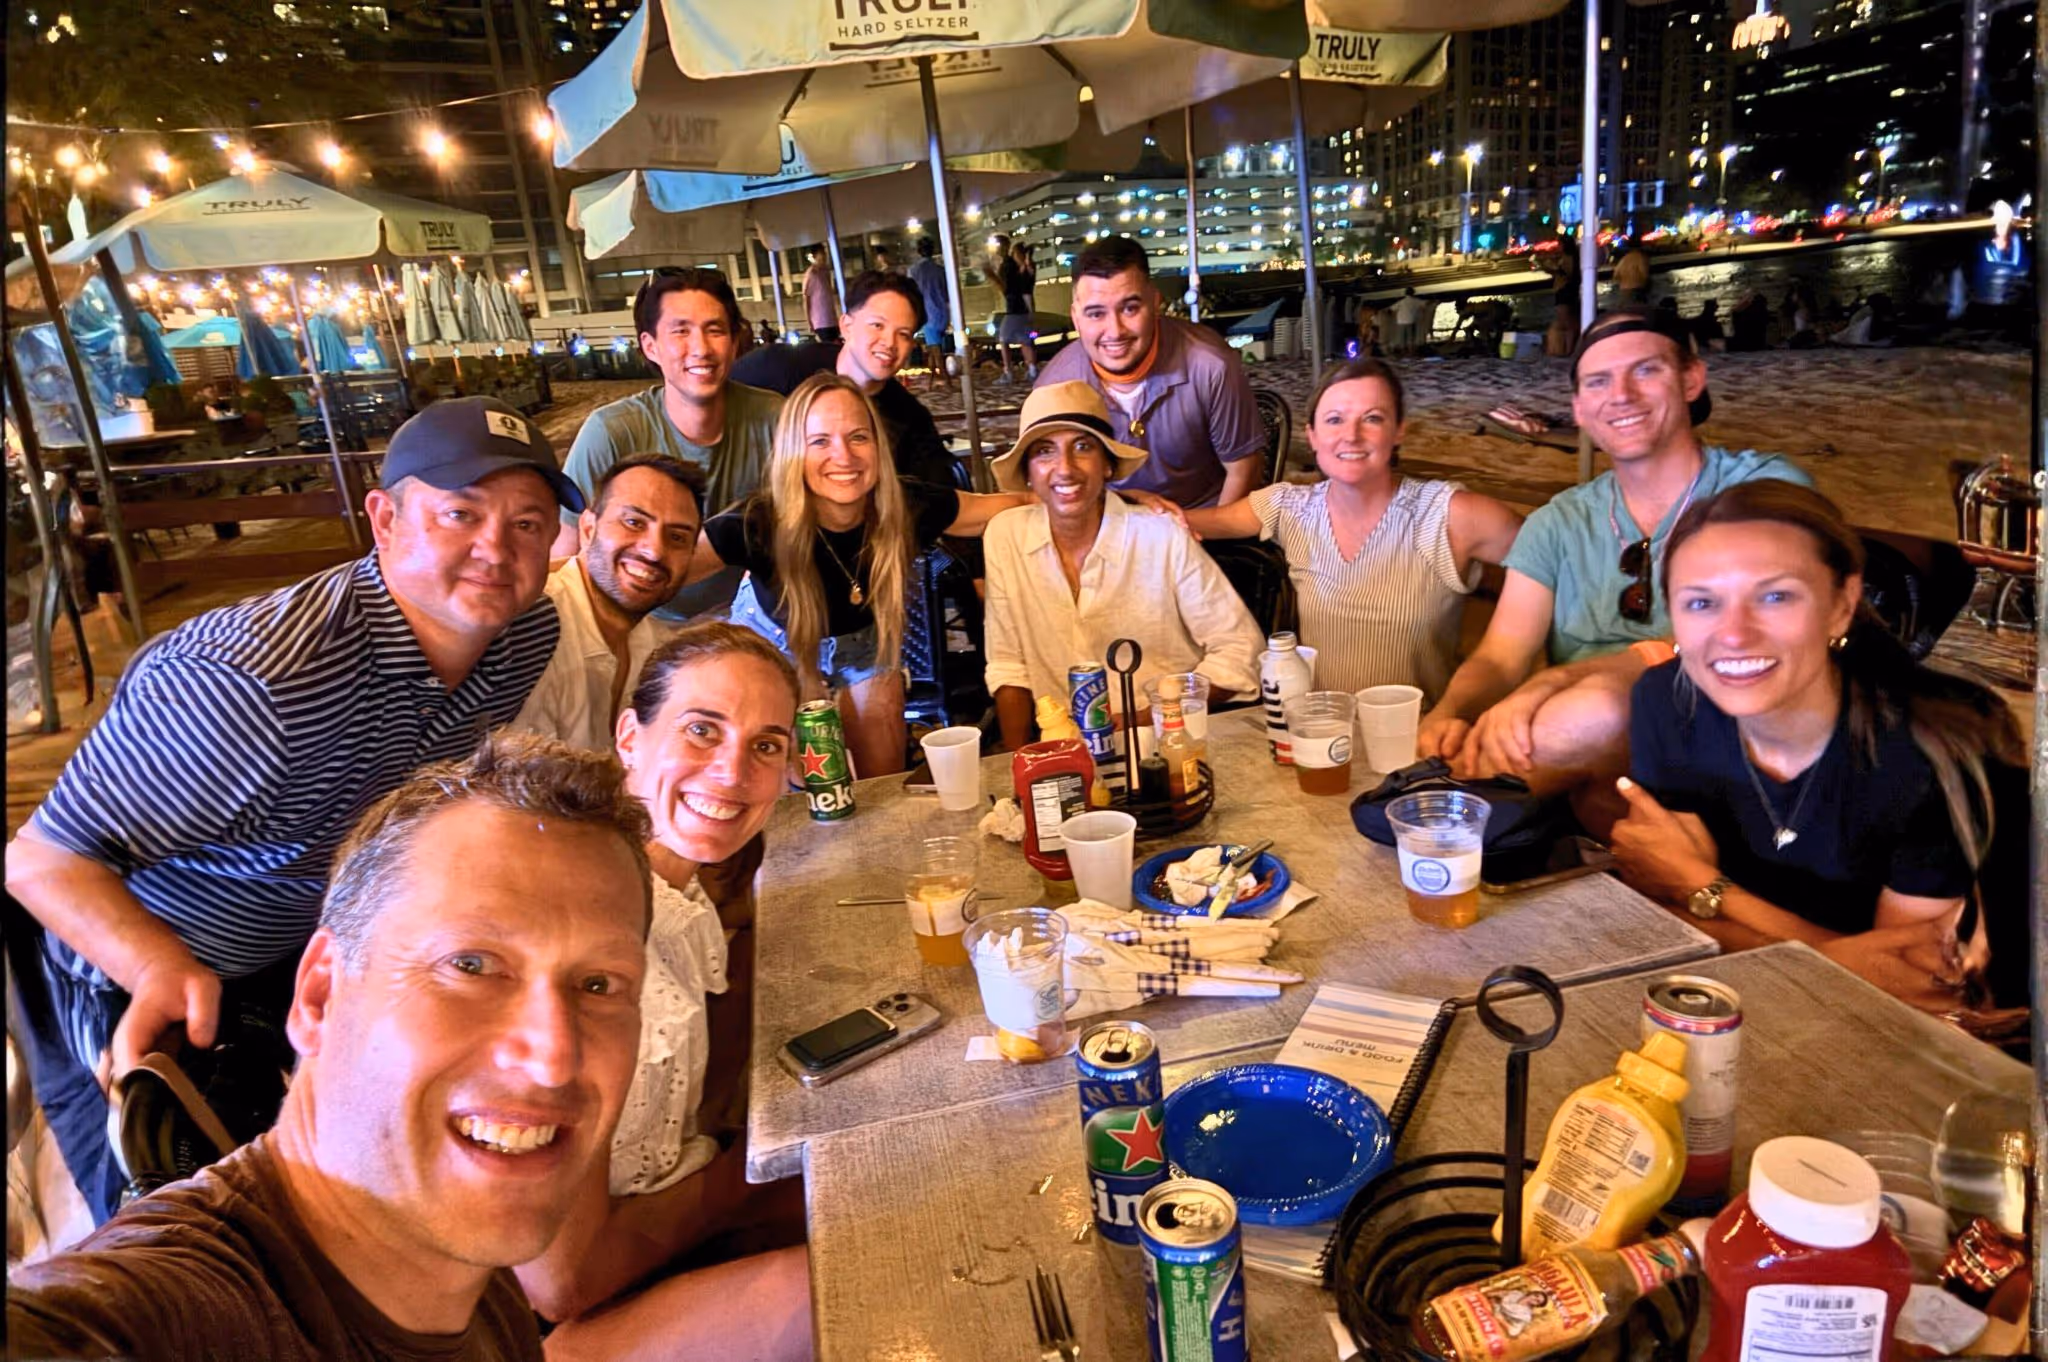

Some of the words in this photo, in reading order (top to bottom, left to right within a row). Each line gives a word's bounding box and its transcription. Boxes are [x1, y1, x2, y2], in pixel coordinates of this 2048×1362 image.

[838, 21, 886, 38] HARD
[894, 16, 969, 31] SELTZER
[1315, 33, 1381, 61] TRULY
[204, 197, 311, 210] TRULY
[1362, 1051, 1404, 1063] FOOD
[1092, 1178, 1143, 1227] in
